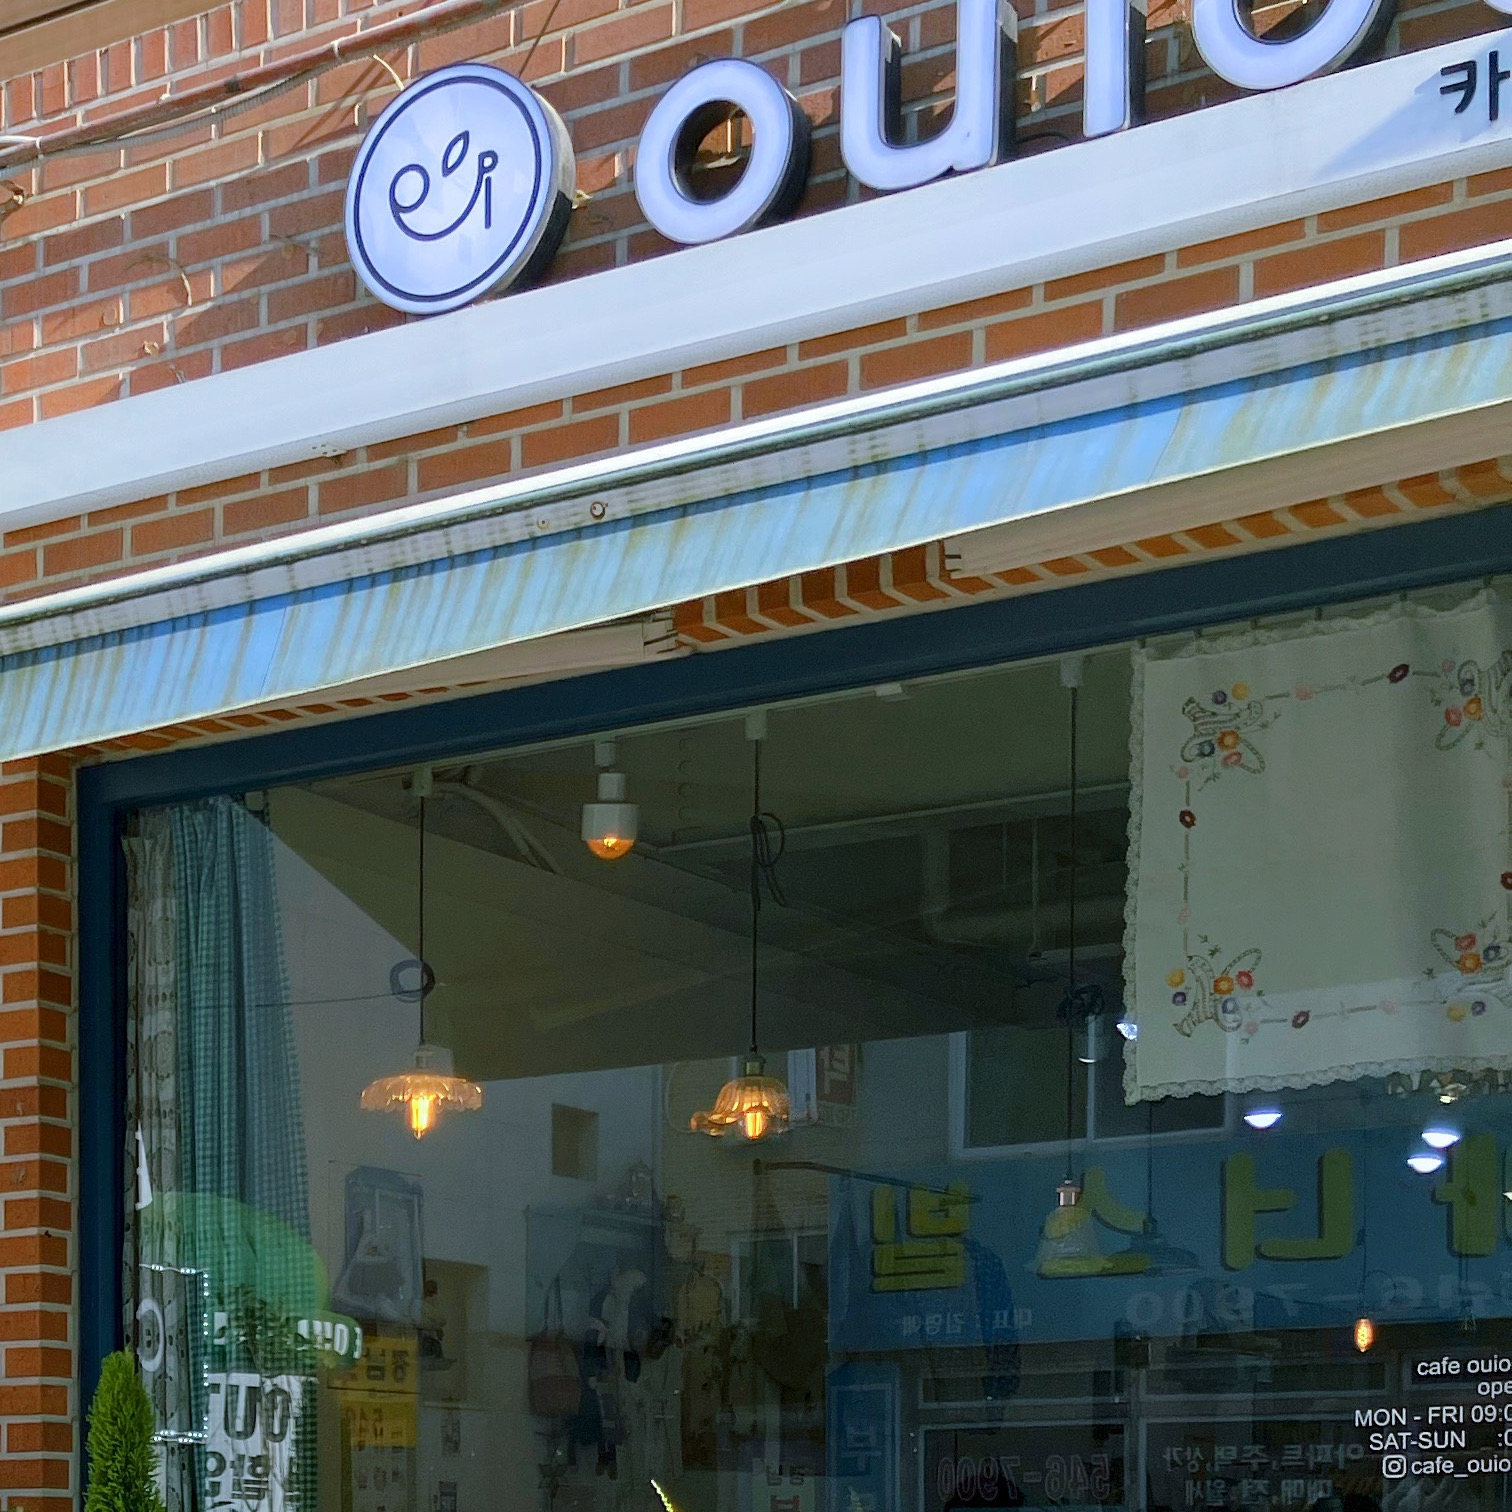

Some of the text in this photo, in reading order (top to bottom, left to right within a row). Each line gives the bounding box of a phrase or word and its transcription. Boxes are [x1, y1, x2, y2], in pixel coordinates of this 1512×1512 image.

[1439, 50, 1511, 122] 카
[635, 0, 1512, 245] ouio
[1417, 1356, 1461, 1376] cafe
[1354, 1407, 1407, 1427] MON
[1428, 1405, 1464, 1425] FRI
[1369, 1430, 1467, 1451] SAT-SUN
